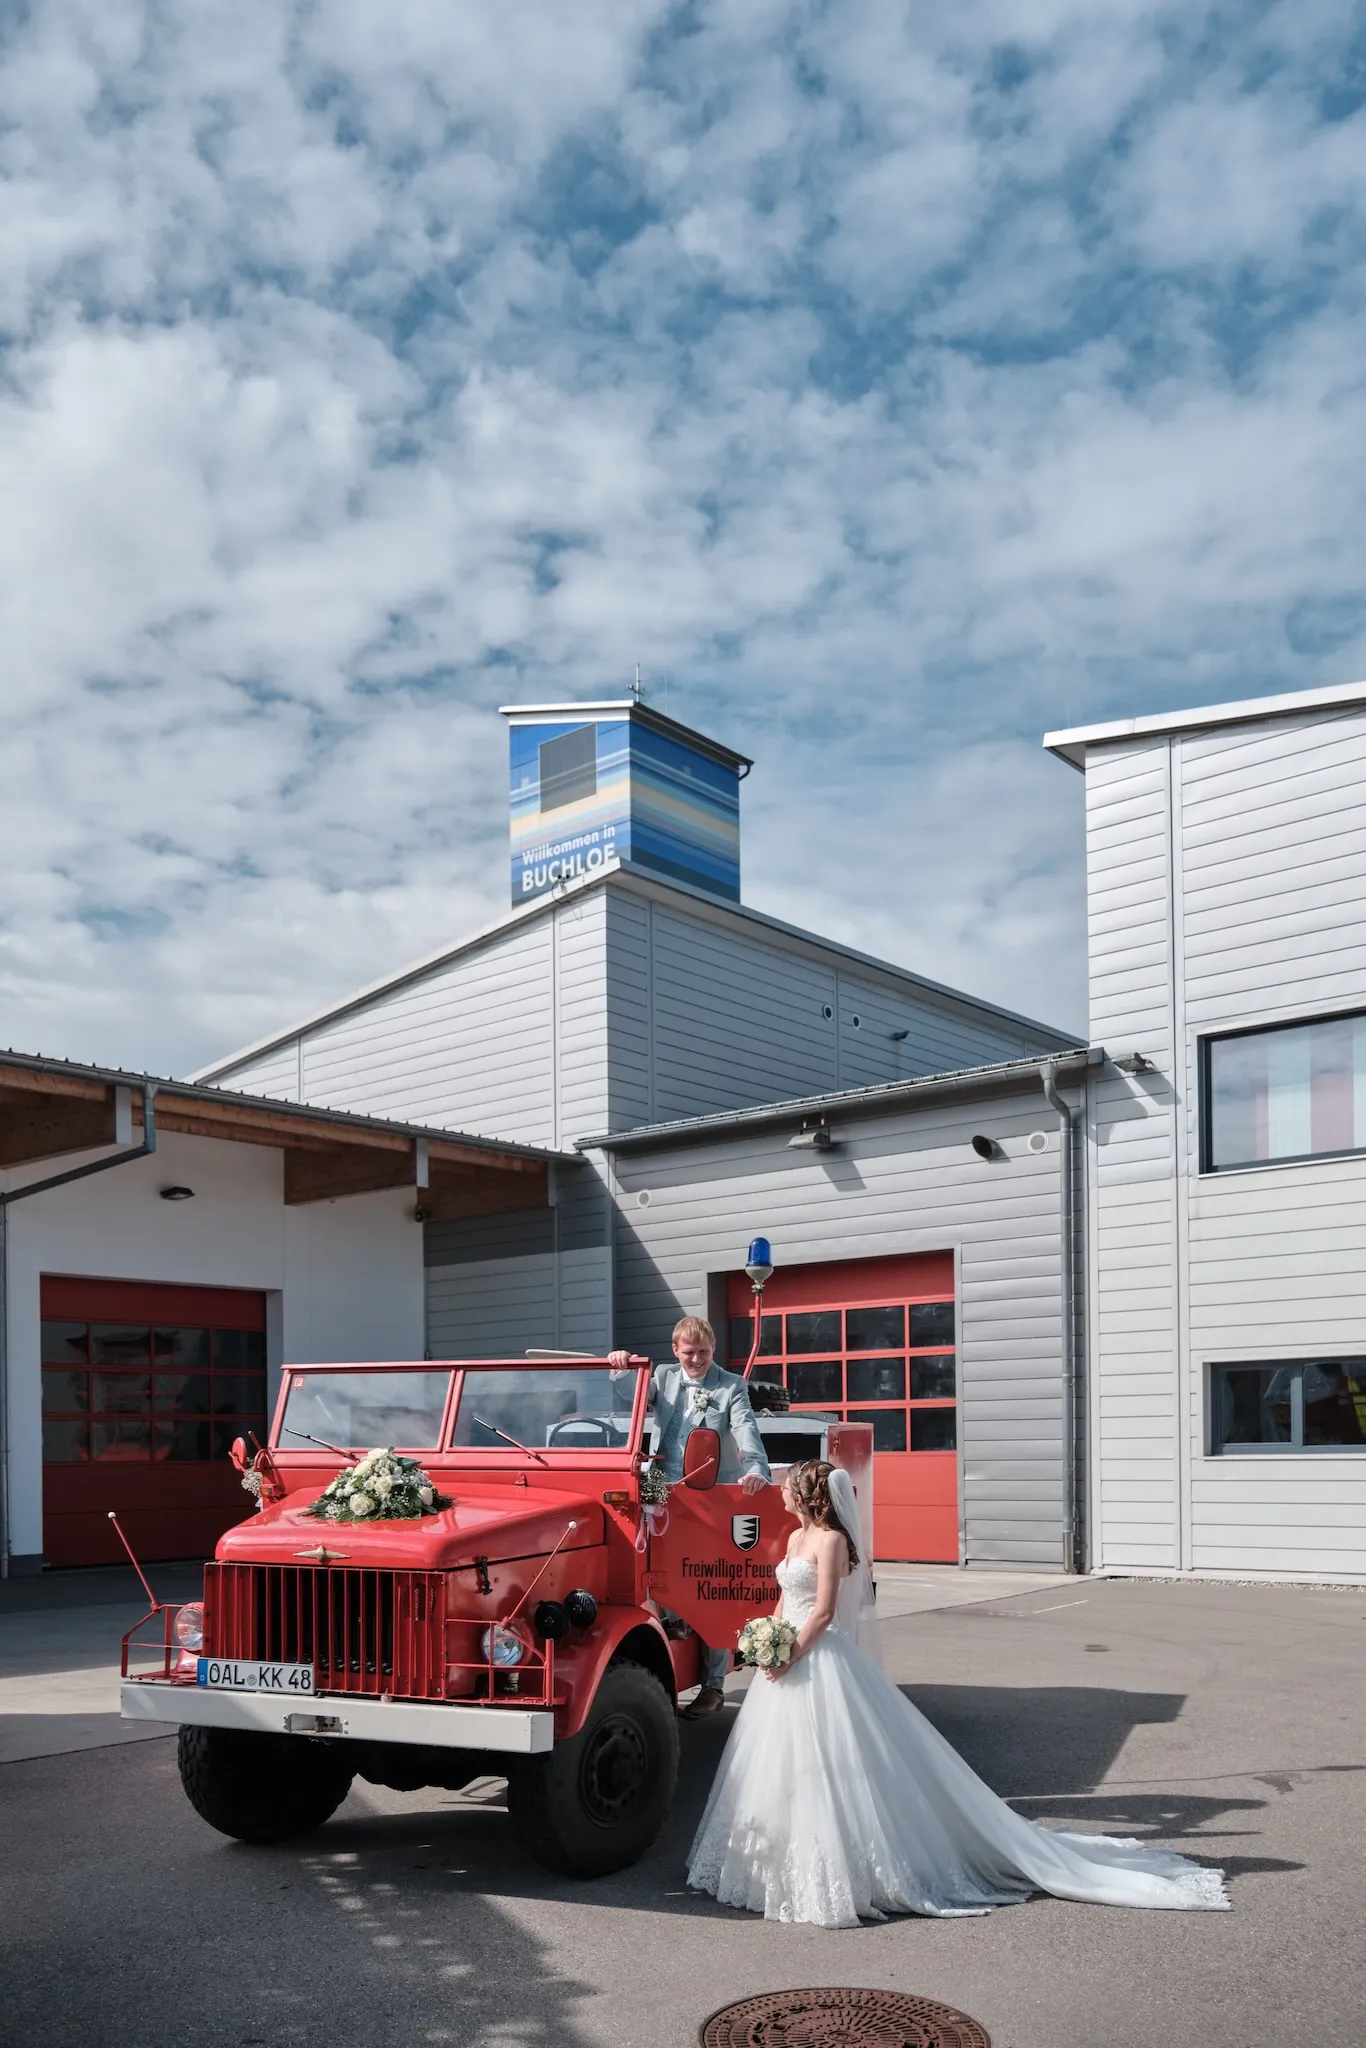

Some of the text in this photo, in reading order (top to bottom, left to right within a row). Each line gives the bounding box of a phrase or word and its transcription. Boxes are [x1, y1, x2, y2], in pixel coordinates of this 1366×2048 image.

[522, 824, 616, 865] Willkommen in
[682, 1557, 743, 1581] Freiwillige
[209, 1663, 311, 1689] OAL KK 48
